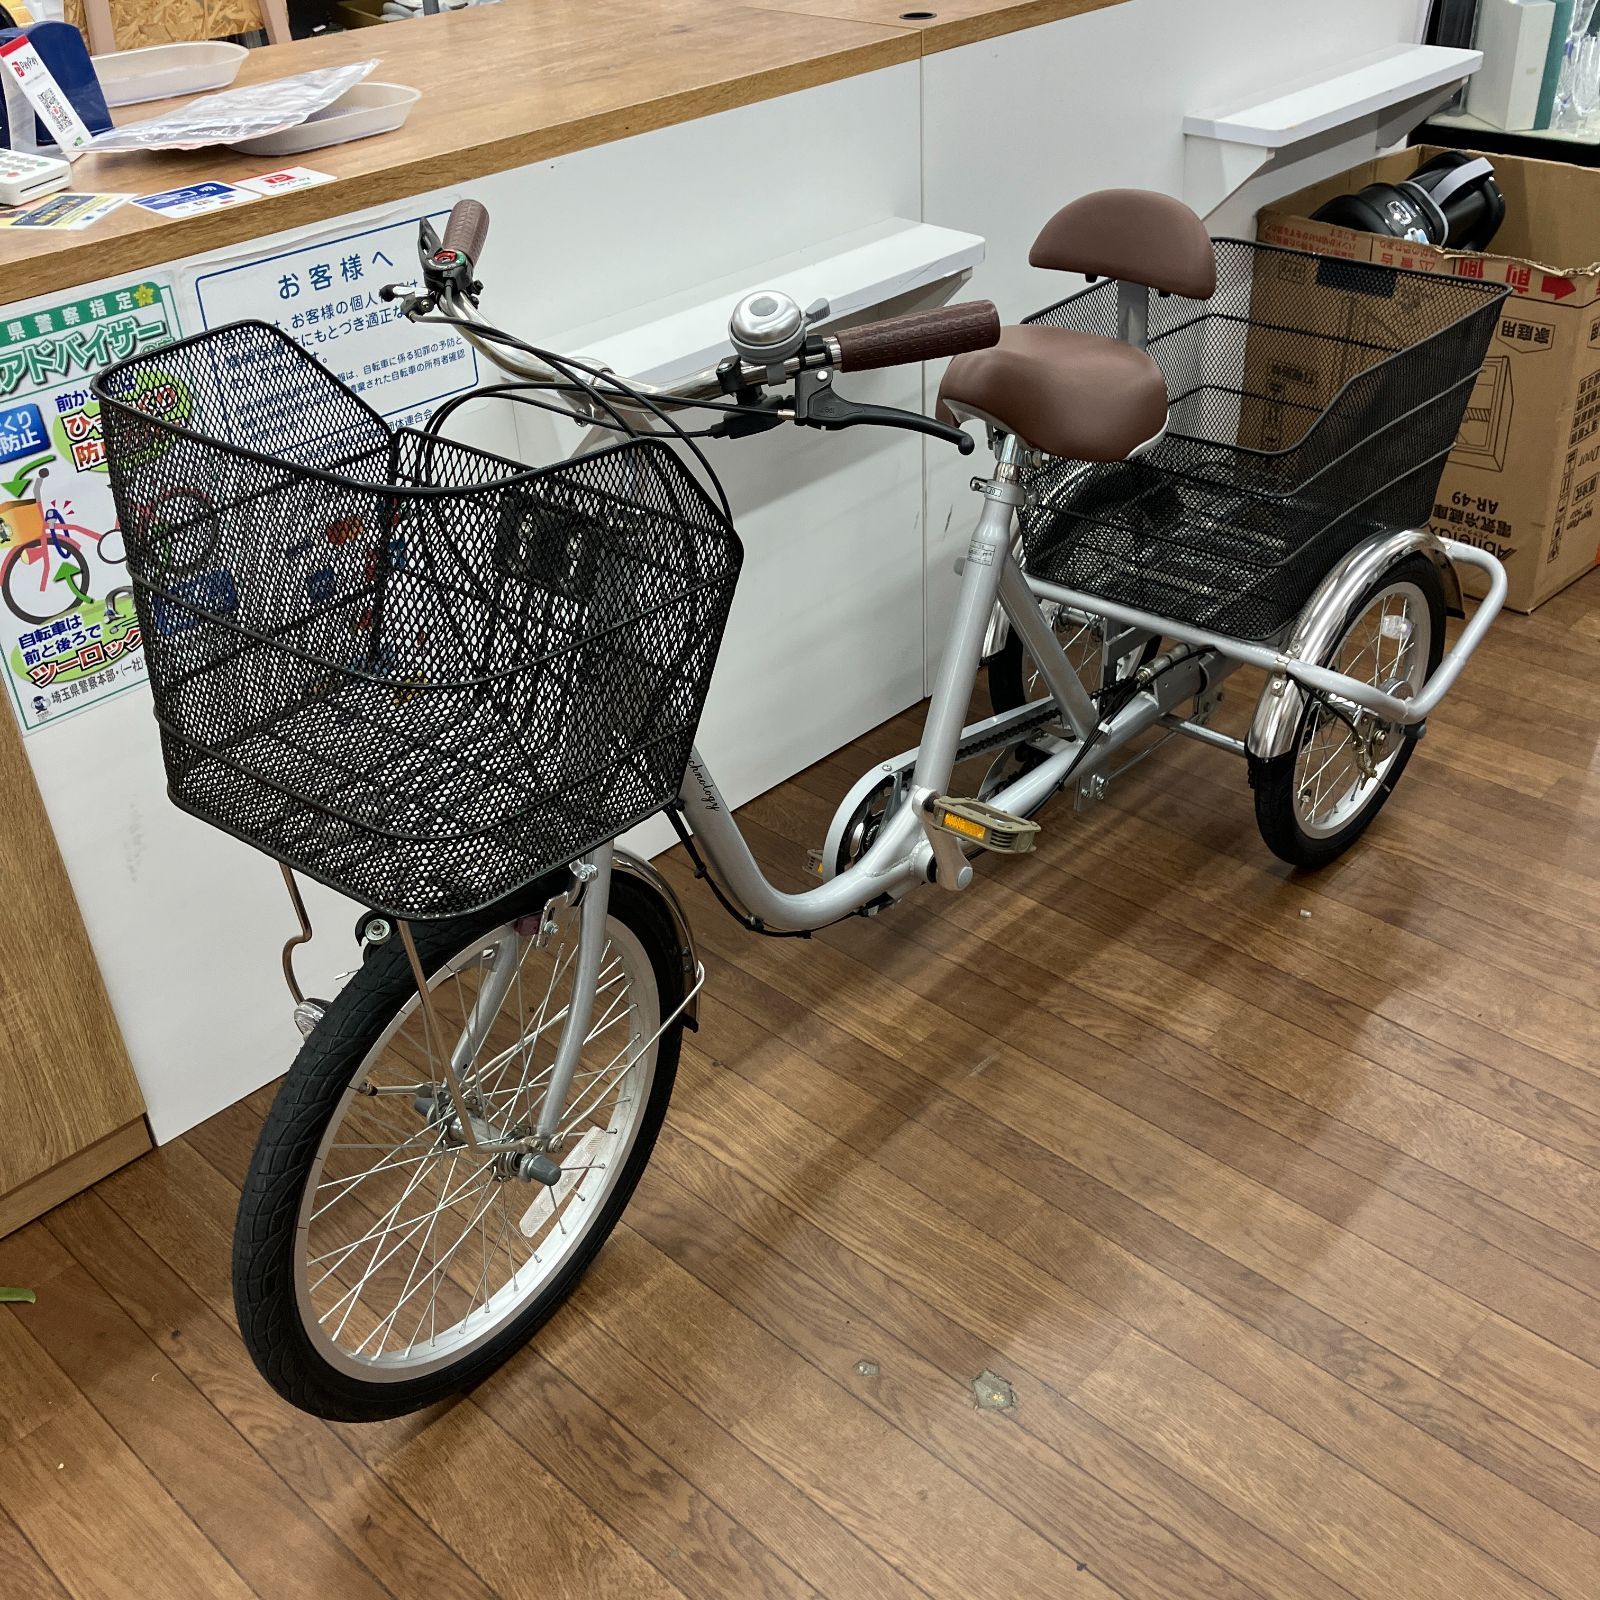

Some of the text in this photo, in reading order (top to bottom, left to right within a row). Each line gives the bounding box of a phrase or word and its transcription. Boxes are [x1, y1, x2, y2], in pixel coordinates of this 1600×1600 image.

[21, 56, 38, 71] PayPay
[277, 250, 394, 300] お客様へ
[7, 292, 133, 341] 県警察指定
[1500, 320, 1551, 345] 家庭用
[0, 316, 166, 392] アドバイザー
[0, 411, 31, 432] くり
[0, 429, 40, 457] 防止
[1451, 492, 1499, 515] AR-49
[1432, 504, 1512, 539] 電気冷蔵庫
[18, 615, 82, 649] 自転車は
[23, 624, 102, 664] 前と後ろで
[28, 627, 143, 688] ツーロック
[688, 756, 720, 811] chnology
